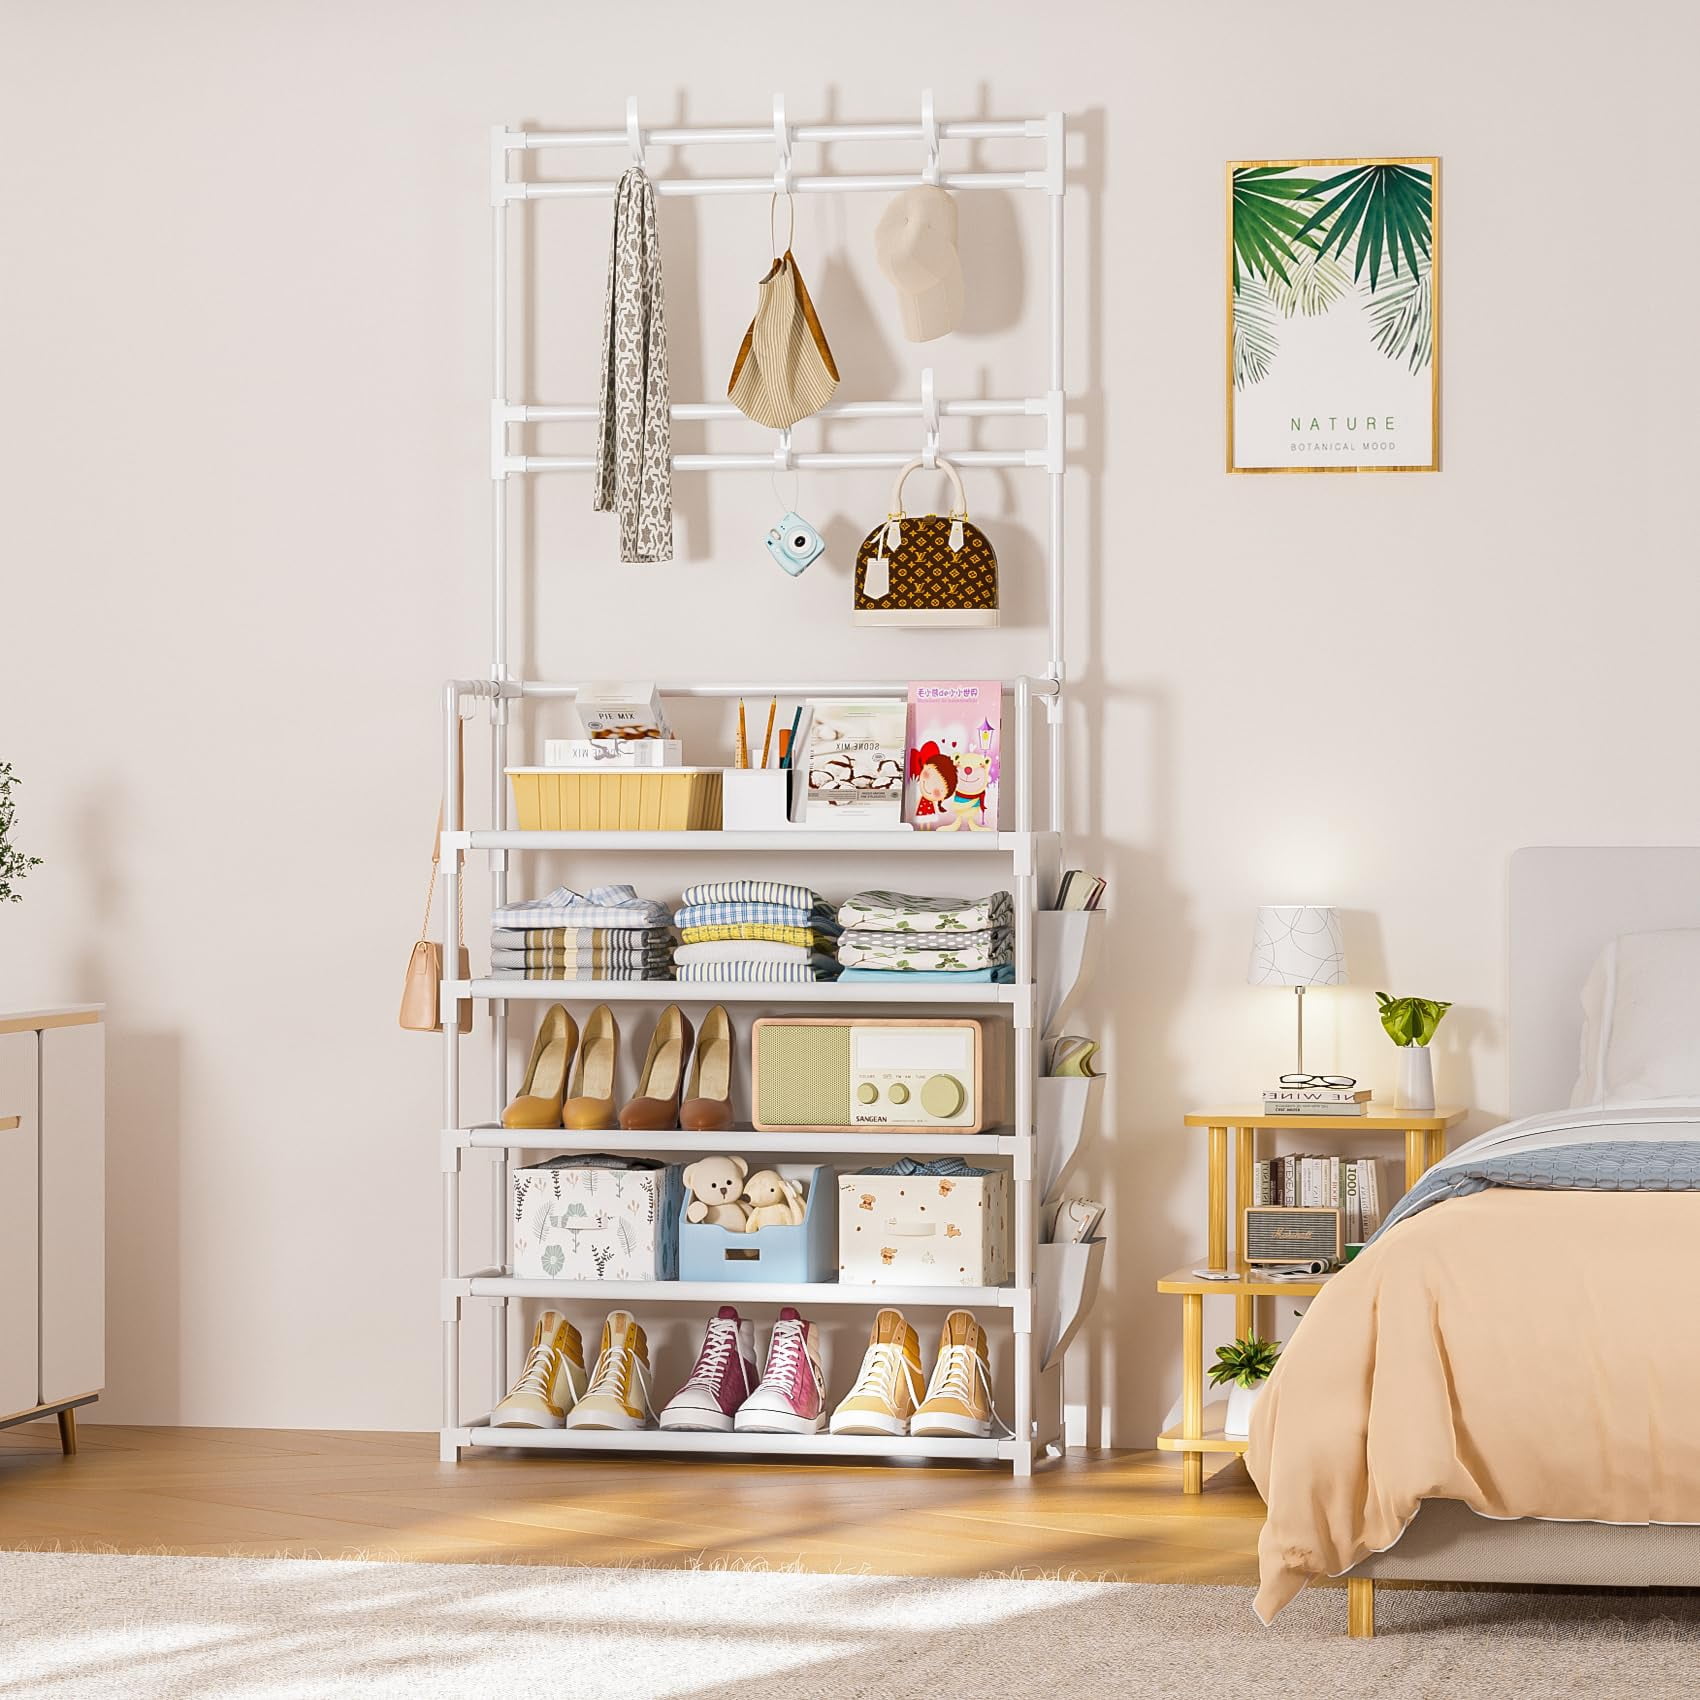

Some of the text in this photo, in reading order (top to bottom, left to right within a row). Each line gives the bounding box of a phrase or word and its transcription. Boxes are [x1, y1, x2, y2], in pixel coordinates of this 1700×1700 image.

[1290, 416, 1395, 431] NATURE
[1290, 442, 1396, 451] BOTANICAL MOOD
[598, 712, 636, 720] PIE MIX
[855, 1115, 888, 1123] SANGEAN
